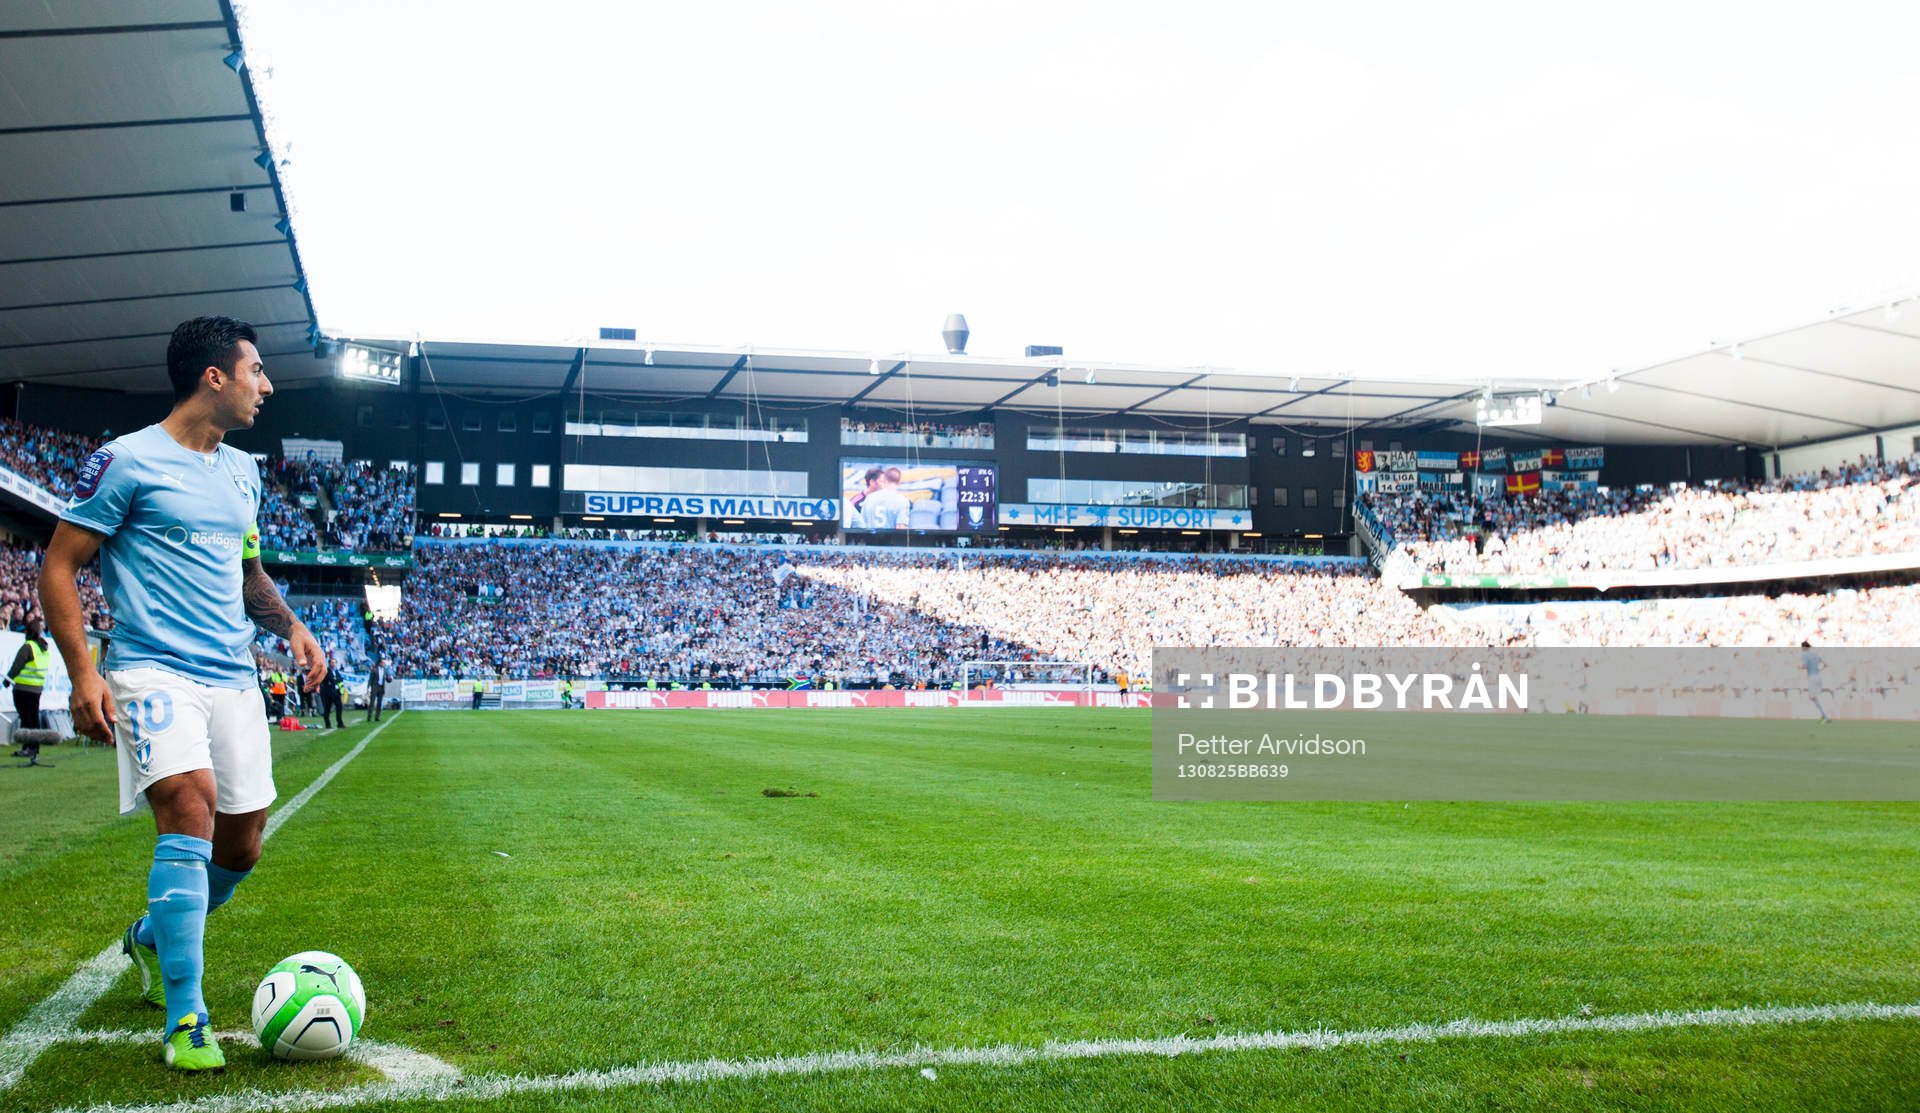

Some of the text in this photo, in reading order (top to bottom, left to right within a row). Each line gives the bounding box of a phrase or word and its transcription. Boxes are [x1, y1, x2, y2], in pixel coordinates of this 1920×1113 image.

[960, 475, 967, 485] 1
[983, 475, 990, 485] 1
[1393, 473, 1415, 481] LIGA
[960, 490, 990, 503] 22:31
[588, 495, 703, 515] SUPRAS
[1034, 505, 1218, 527] MFF SUPPORT
[127, 692, 173, 742] 10
